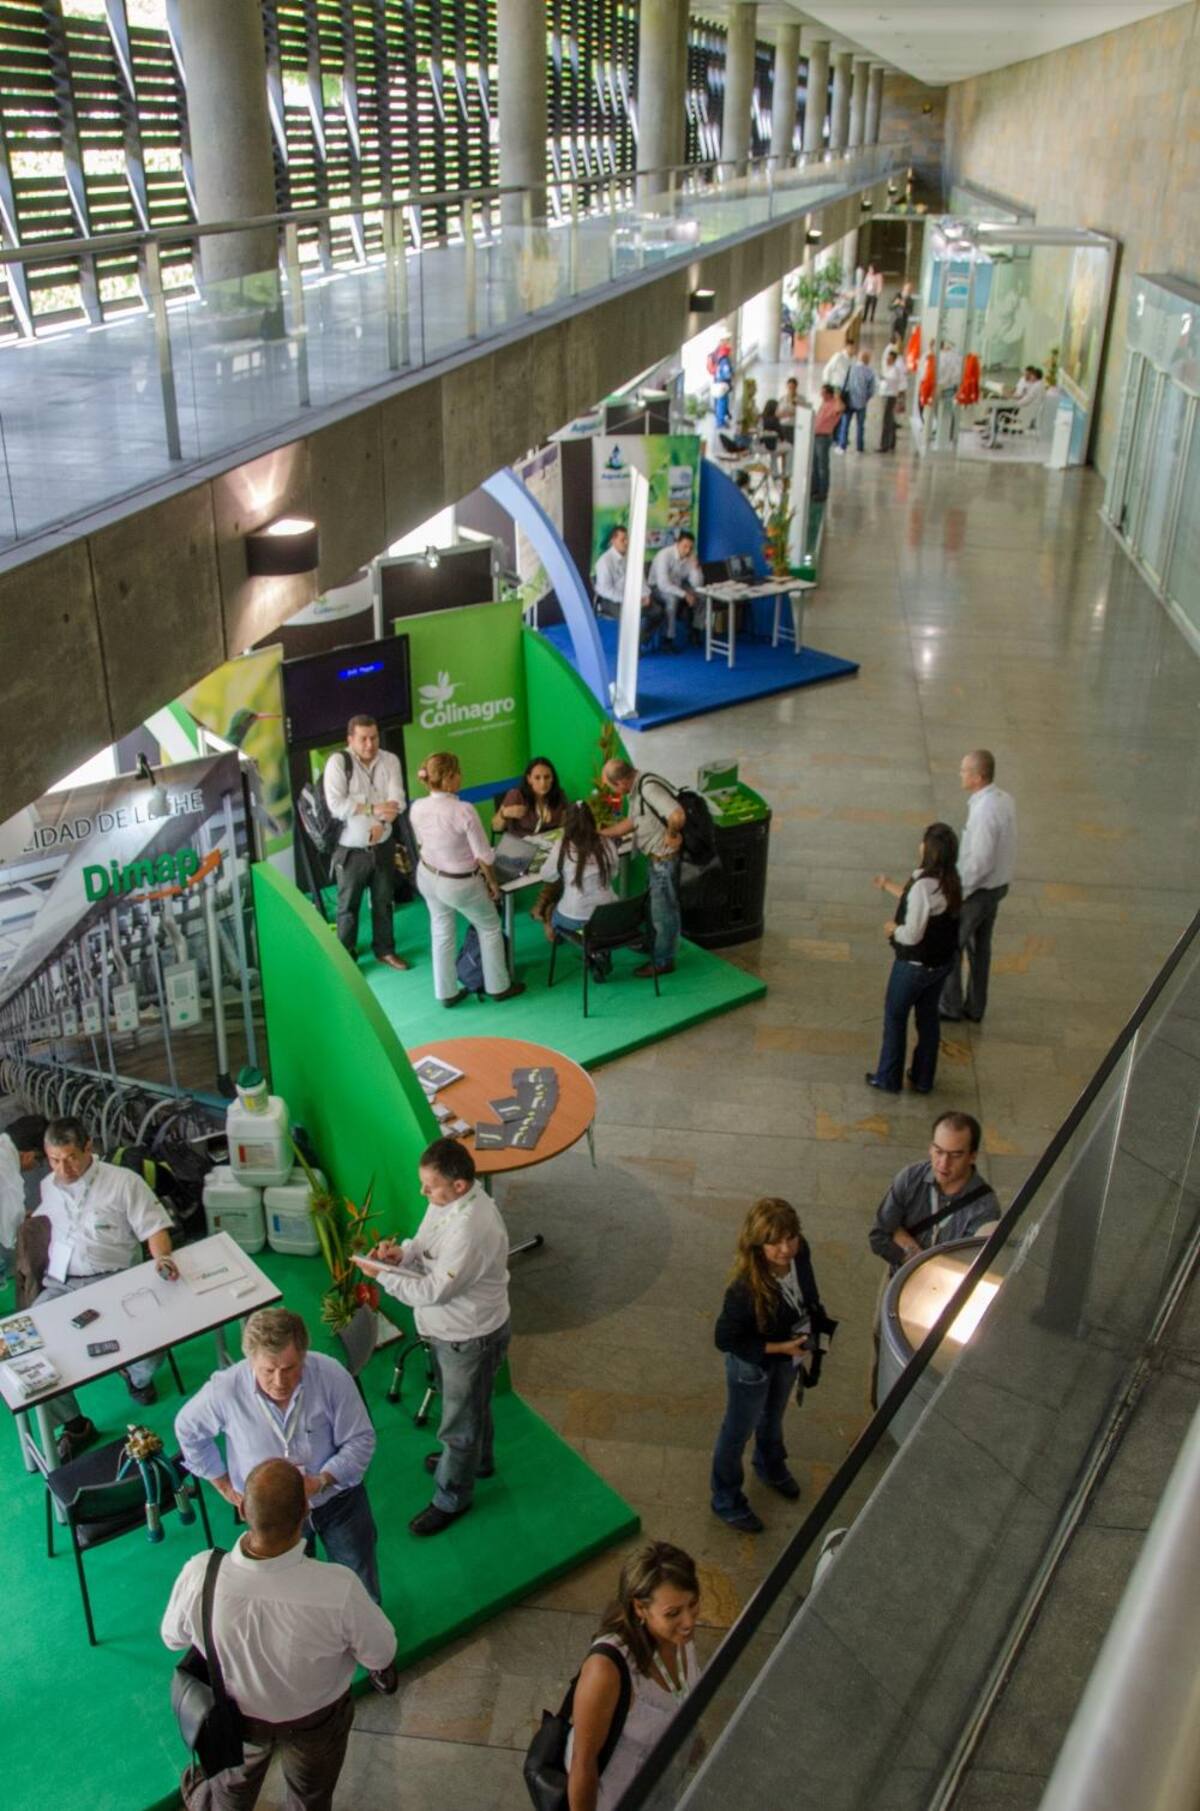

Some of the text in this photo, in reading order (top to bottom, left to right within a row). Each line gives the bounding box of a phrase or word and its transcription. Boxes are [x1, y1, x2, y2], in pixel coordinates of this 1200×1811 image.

[420, 697, 514, 729] Colinagro
[23, 789, 203, 853] IDAD DE LHE
[83, 847, 199, 902] Dimap
